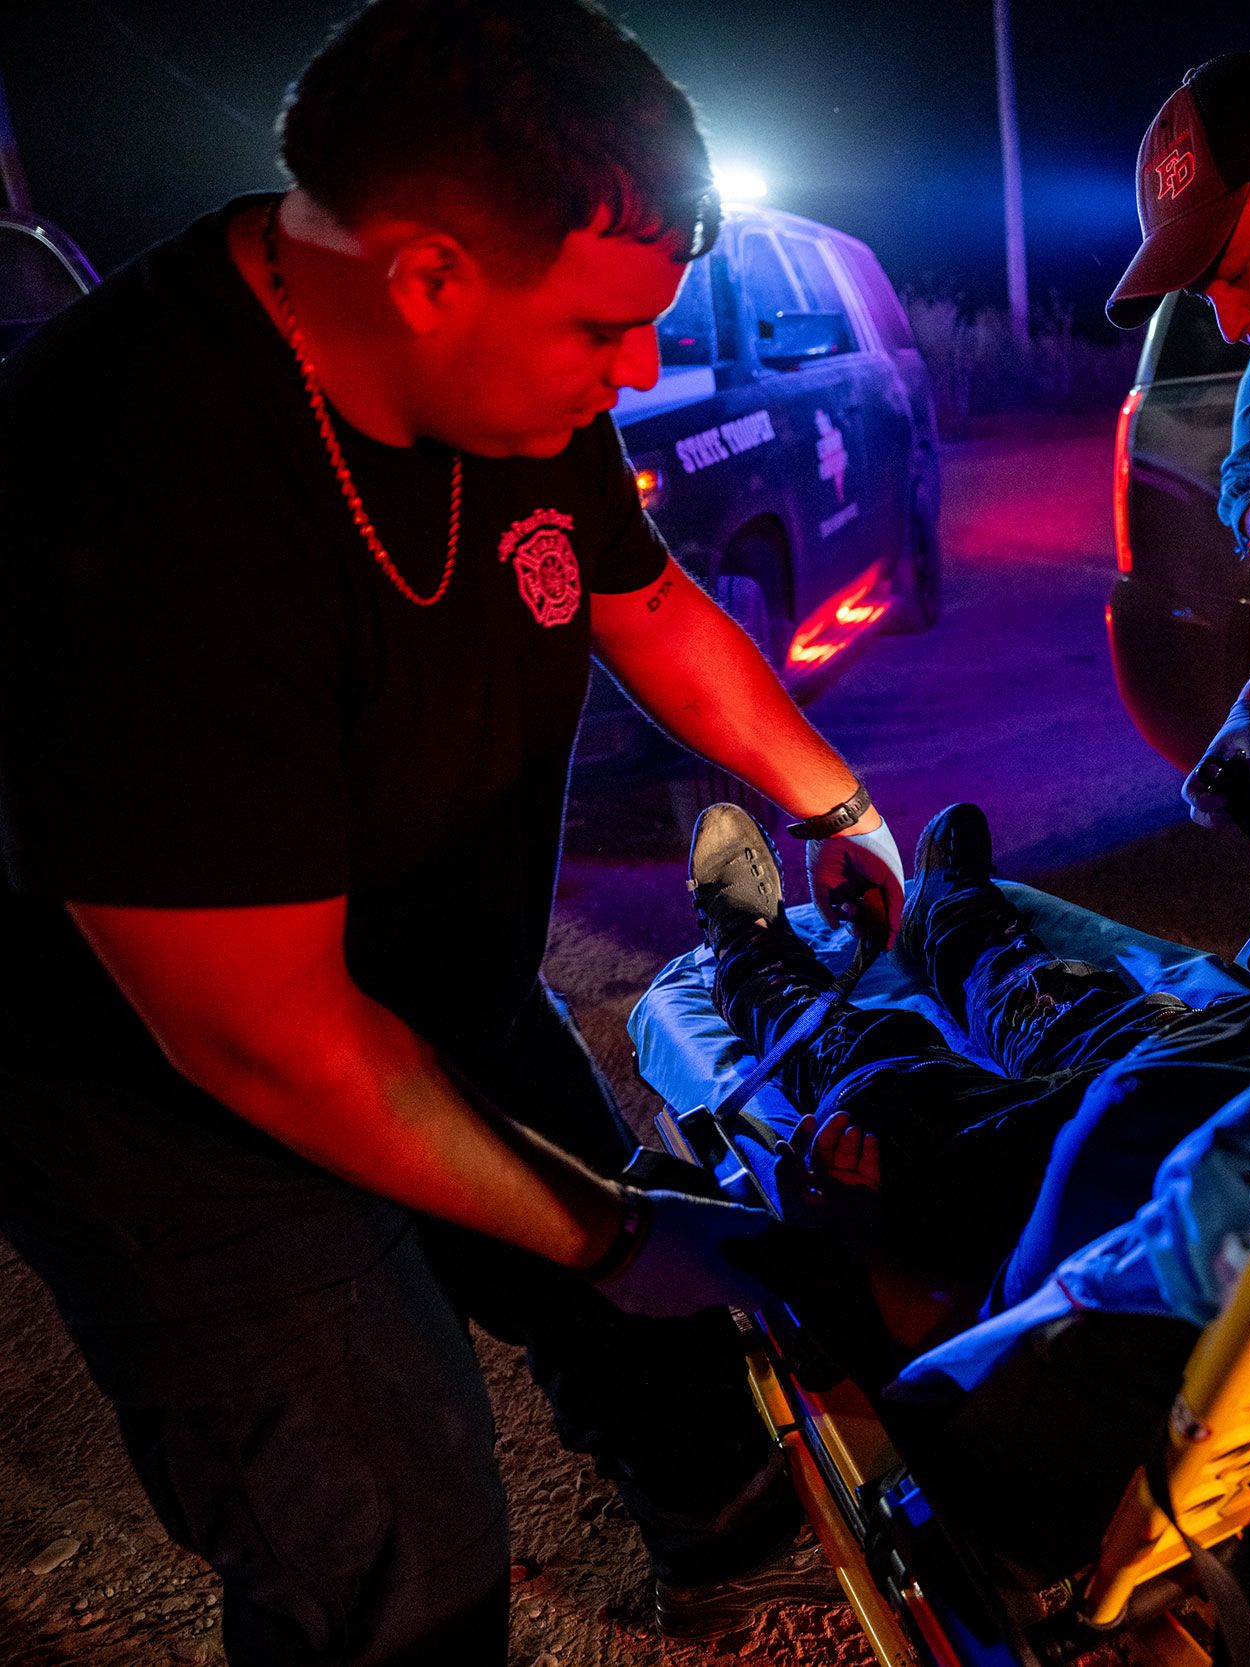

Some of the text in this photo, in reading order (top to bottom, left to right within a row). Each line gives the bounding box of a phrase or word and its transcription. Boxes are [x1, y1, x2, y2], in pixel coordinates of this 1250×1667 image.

[1155, 149, 1195, 200] FD
[675, 410, 776, 474] STATE TROOPER
